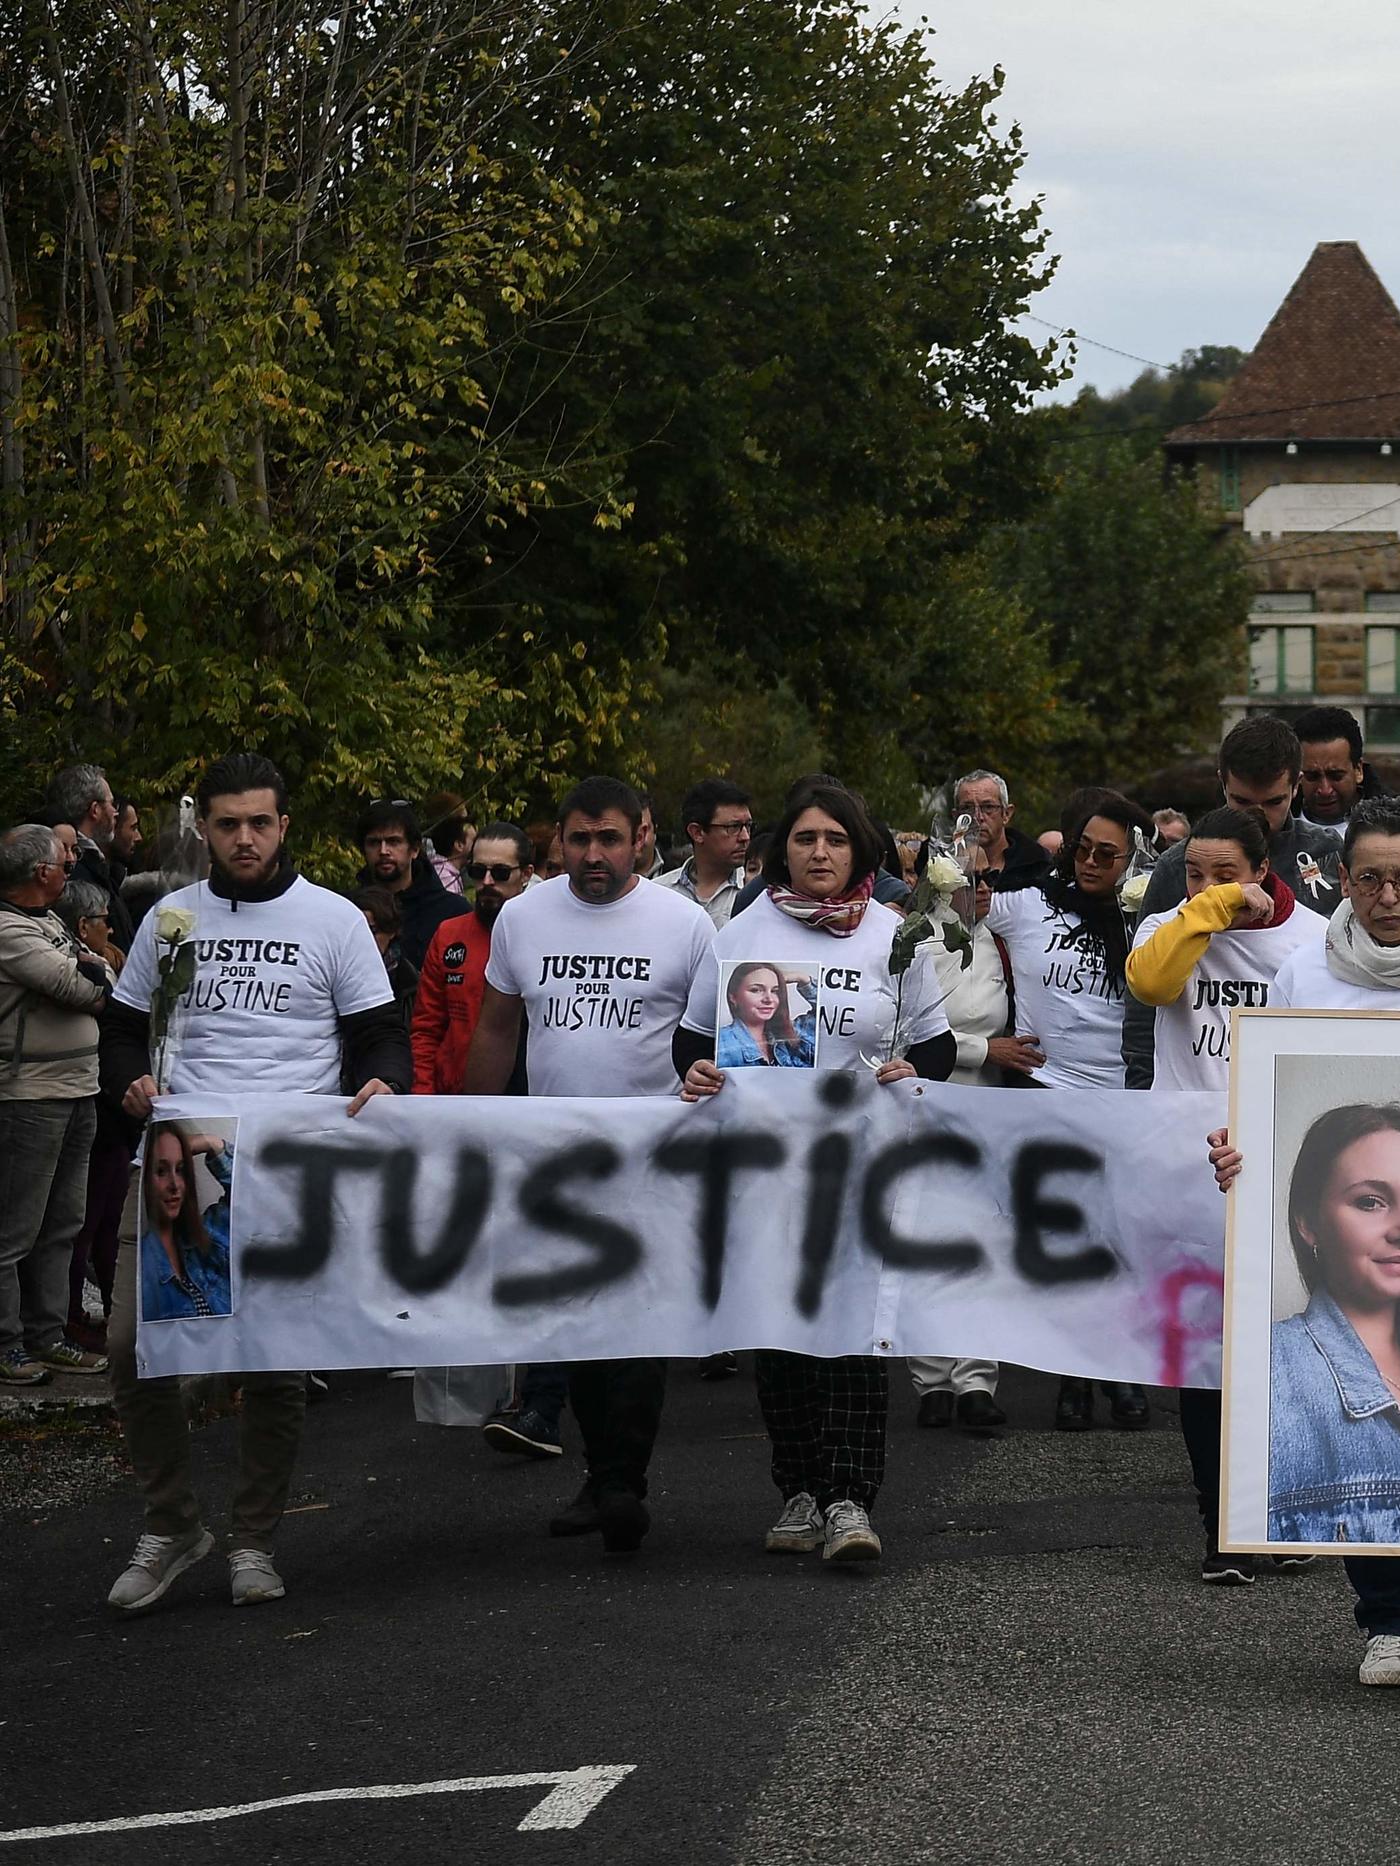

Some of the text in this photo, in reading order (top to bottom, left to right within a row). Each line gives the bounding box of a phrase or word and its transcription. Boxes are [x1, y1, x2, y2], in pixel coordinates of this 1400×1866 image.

[197, 939, 300, 966] USTICE
[220, 966, 256, 977] POUR
[538, 955, 652, 986] JUSTICE
[1043, 962, 1125, 1000] JUSTIN
[575, 983, 610, 995] POUR
[1193, 979, 1268, 1010] JUSTI
[544, 997, 643, 1031] JUSTINE
